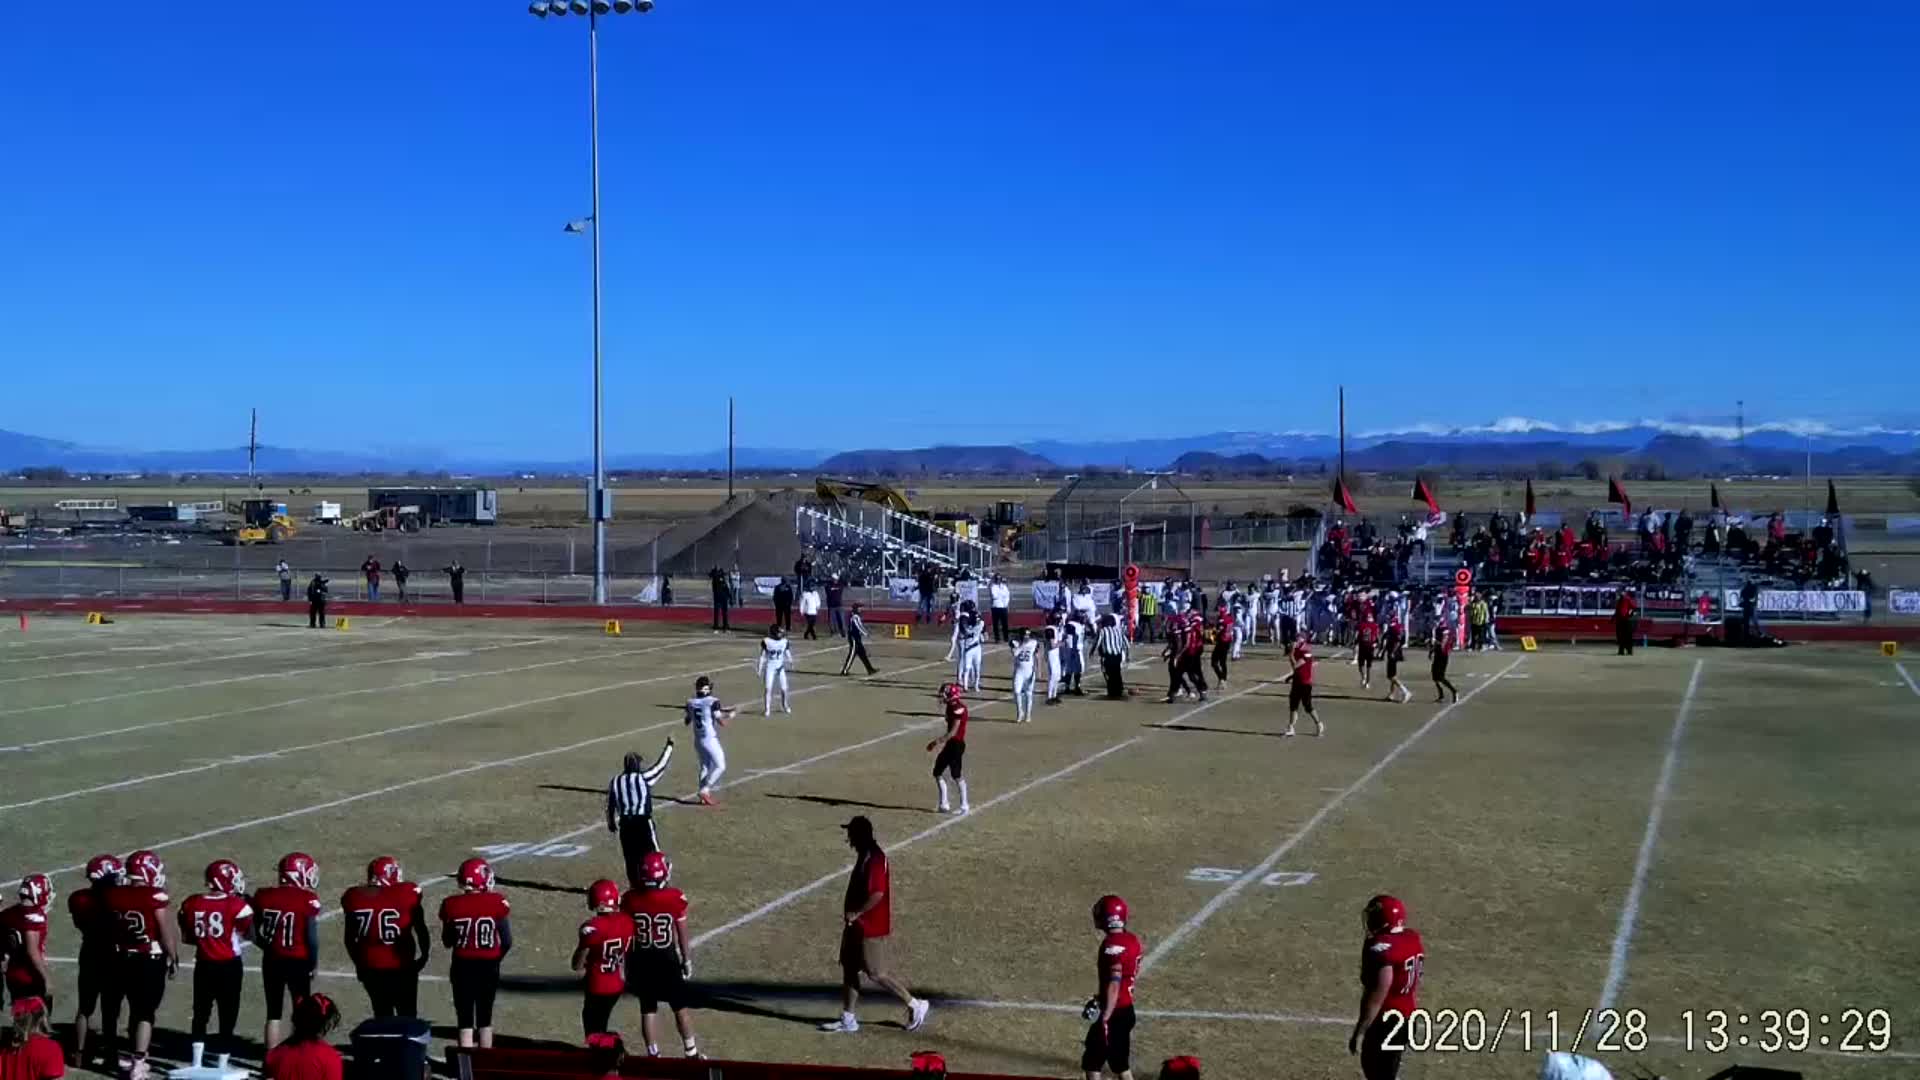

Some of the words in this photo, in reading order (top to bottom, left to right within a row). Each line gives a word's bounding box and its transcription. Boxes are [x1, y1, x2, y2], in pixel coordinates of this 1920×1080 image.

[193, 910, 225, 939] 58
[262, 908, 295, 948] 71
[355, 908, 401, 944] 76
[453, 916, 496, 949] 70
[635, 912, 674, 949] 33
